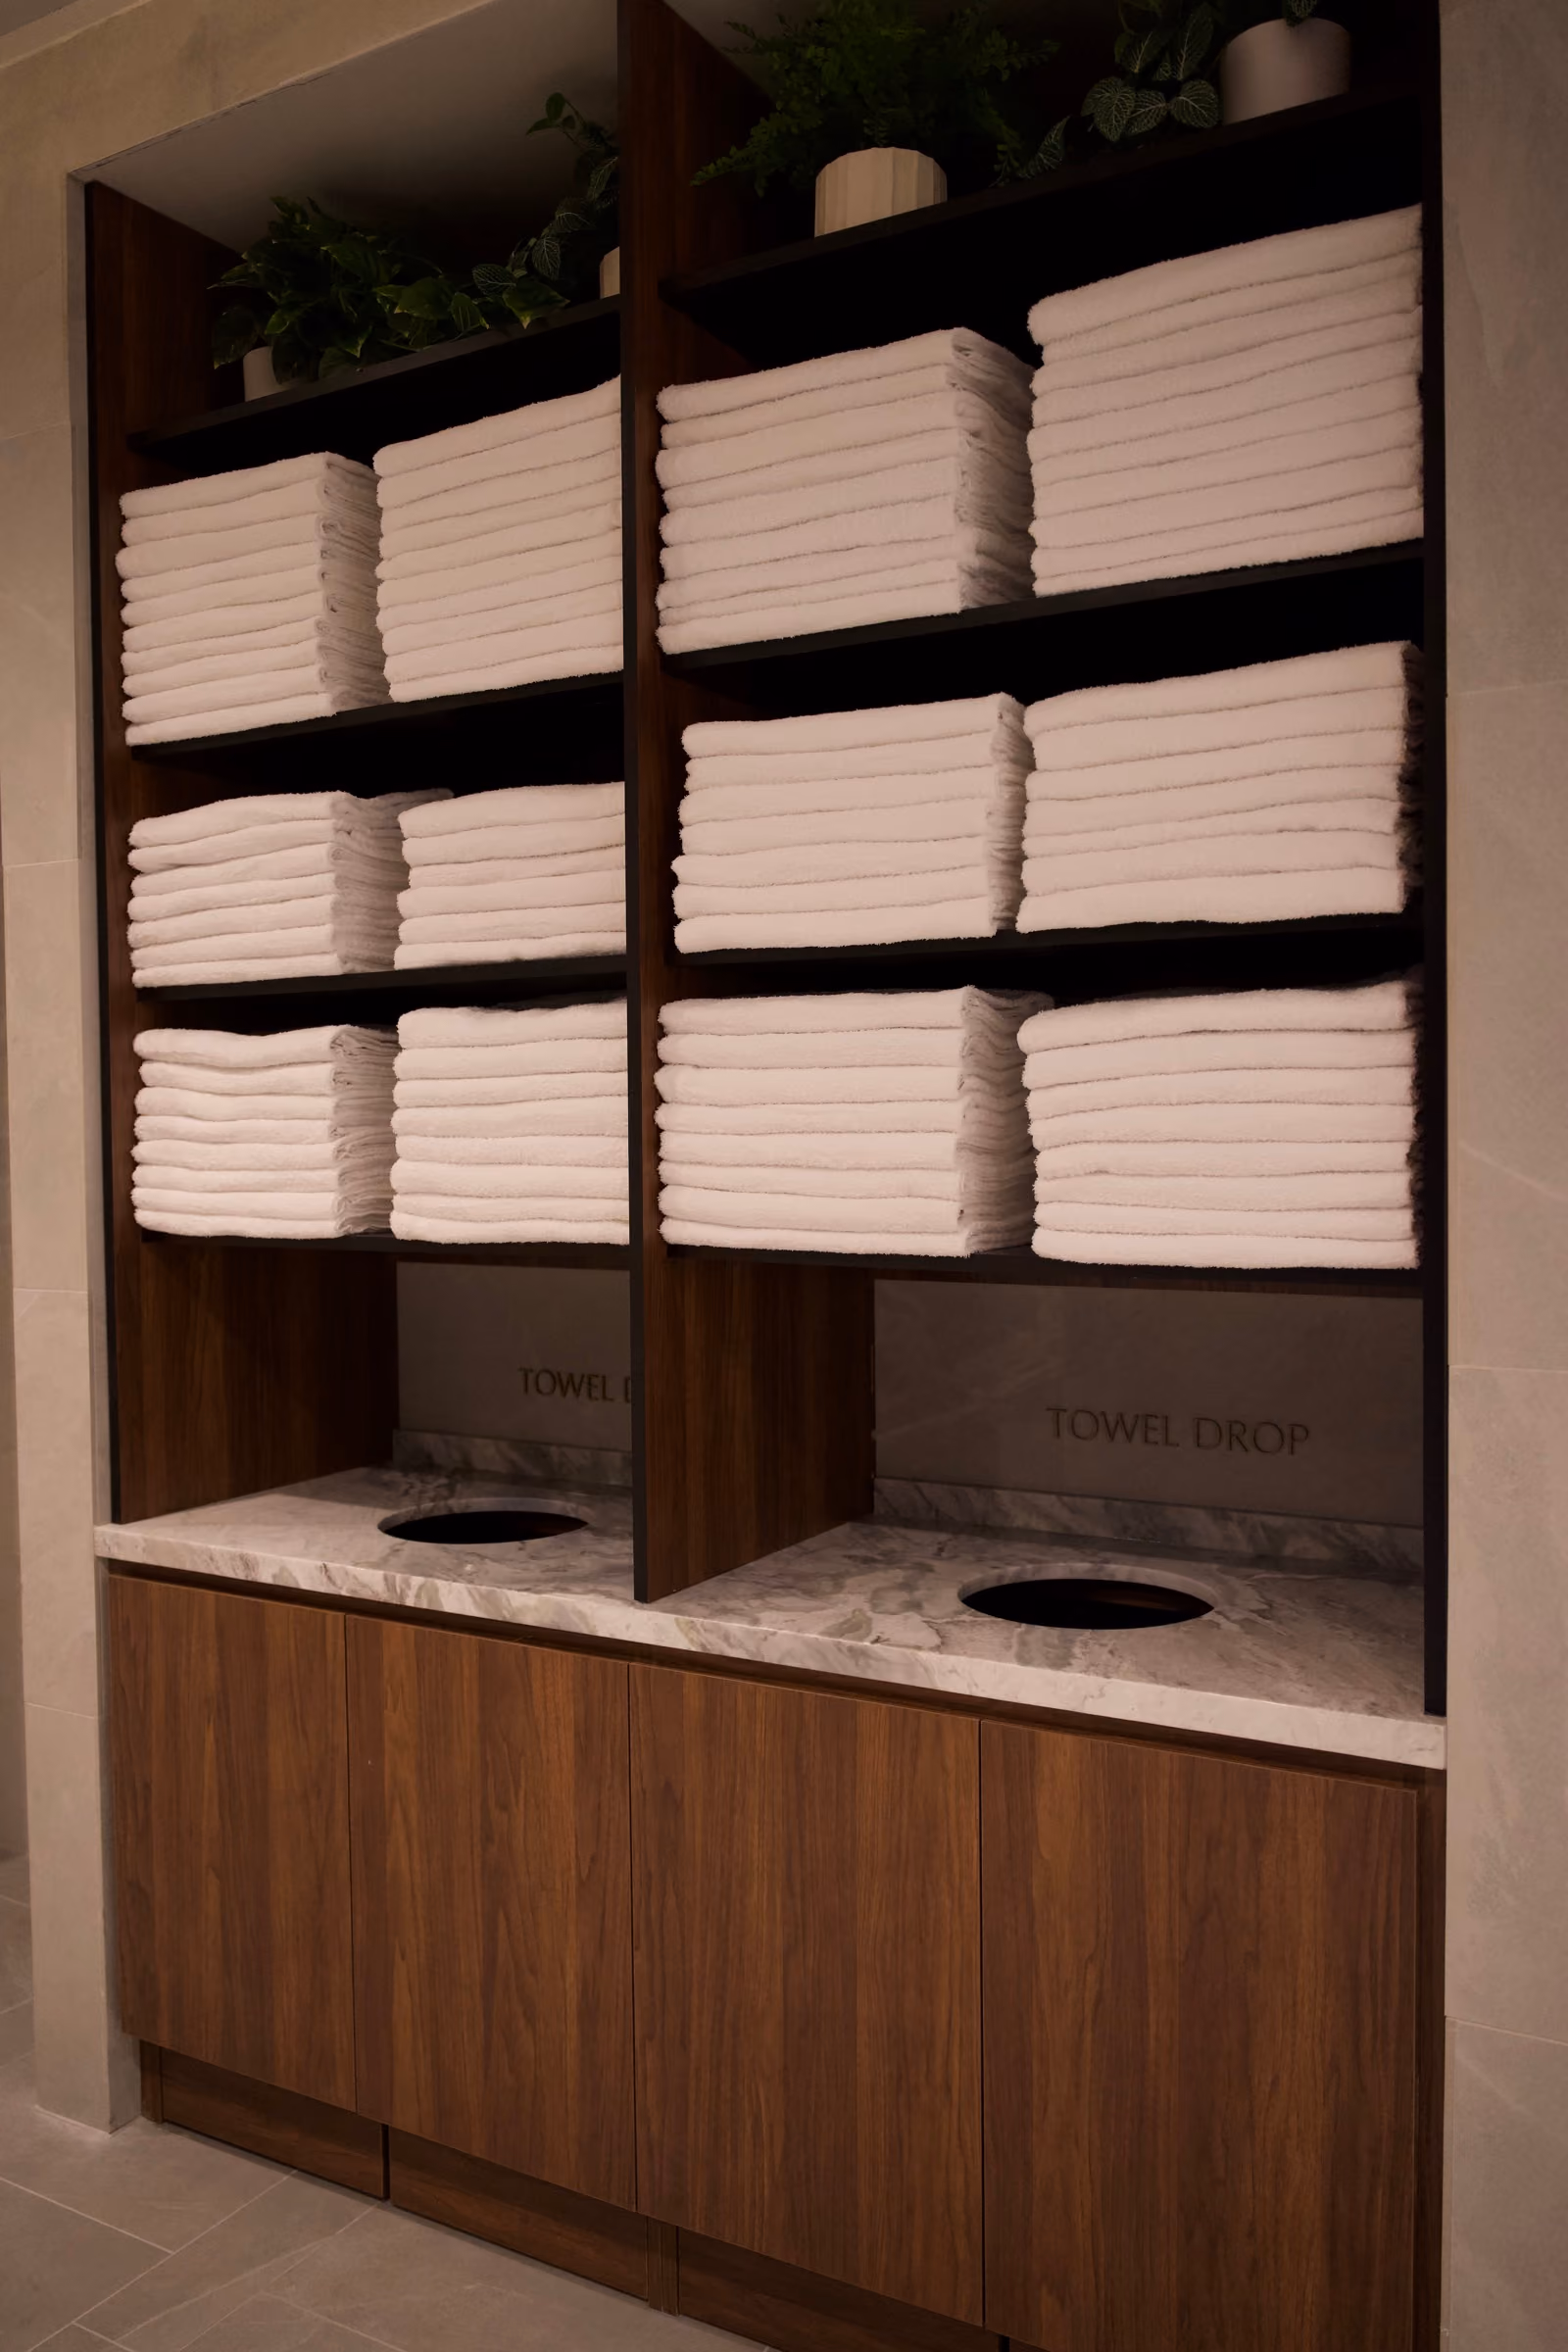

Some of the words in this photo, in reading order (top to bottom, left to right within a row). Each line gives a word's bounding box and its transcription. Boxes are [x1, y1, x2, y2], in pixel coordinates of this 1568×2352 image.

[516, 1366, 614, 1402] TOWEL
[1045, 1406, 1180, 1447] TOWEL
[1193, 1416, 1310, 1455] DROP
